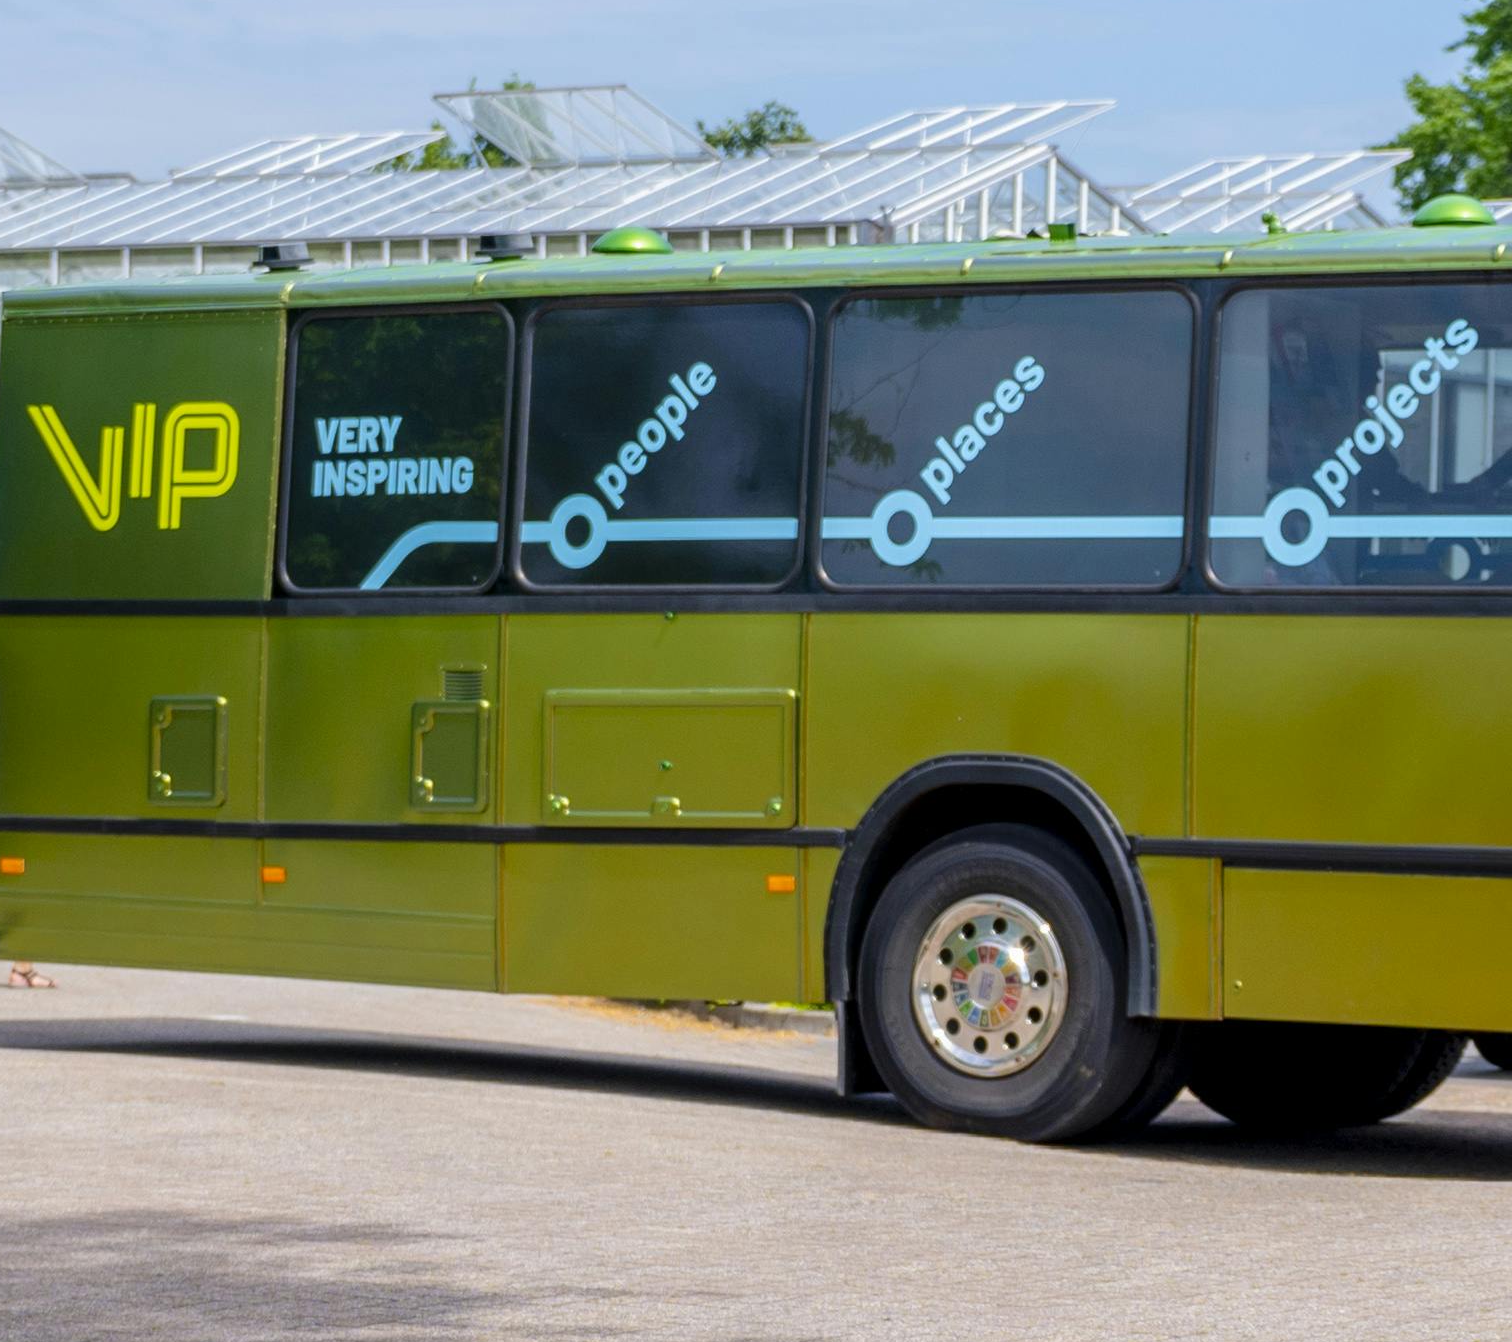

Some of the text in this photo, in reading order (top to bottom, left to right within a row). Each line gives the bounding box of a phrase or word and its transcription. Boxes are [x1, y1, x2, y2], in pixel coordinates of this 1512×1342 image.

[27, 401, 240, 532] VIP
[311, 456, 475, 498] INSPIRING
[314, 415, 403, 454] VERY
[593, 360, 718, 509] people
[920, 352, 1048, 506] places
[1313, 318, 1479, 508] projects
